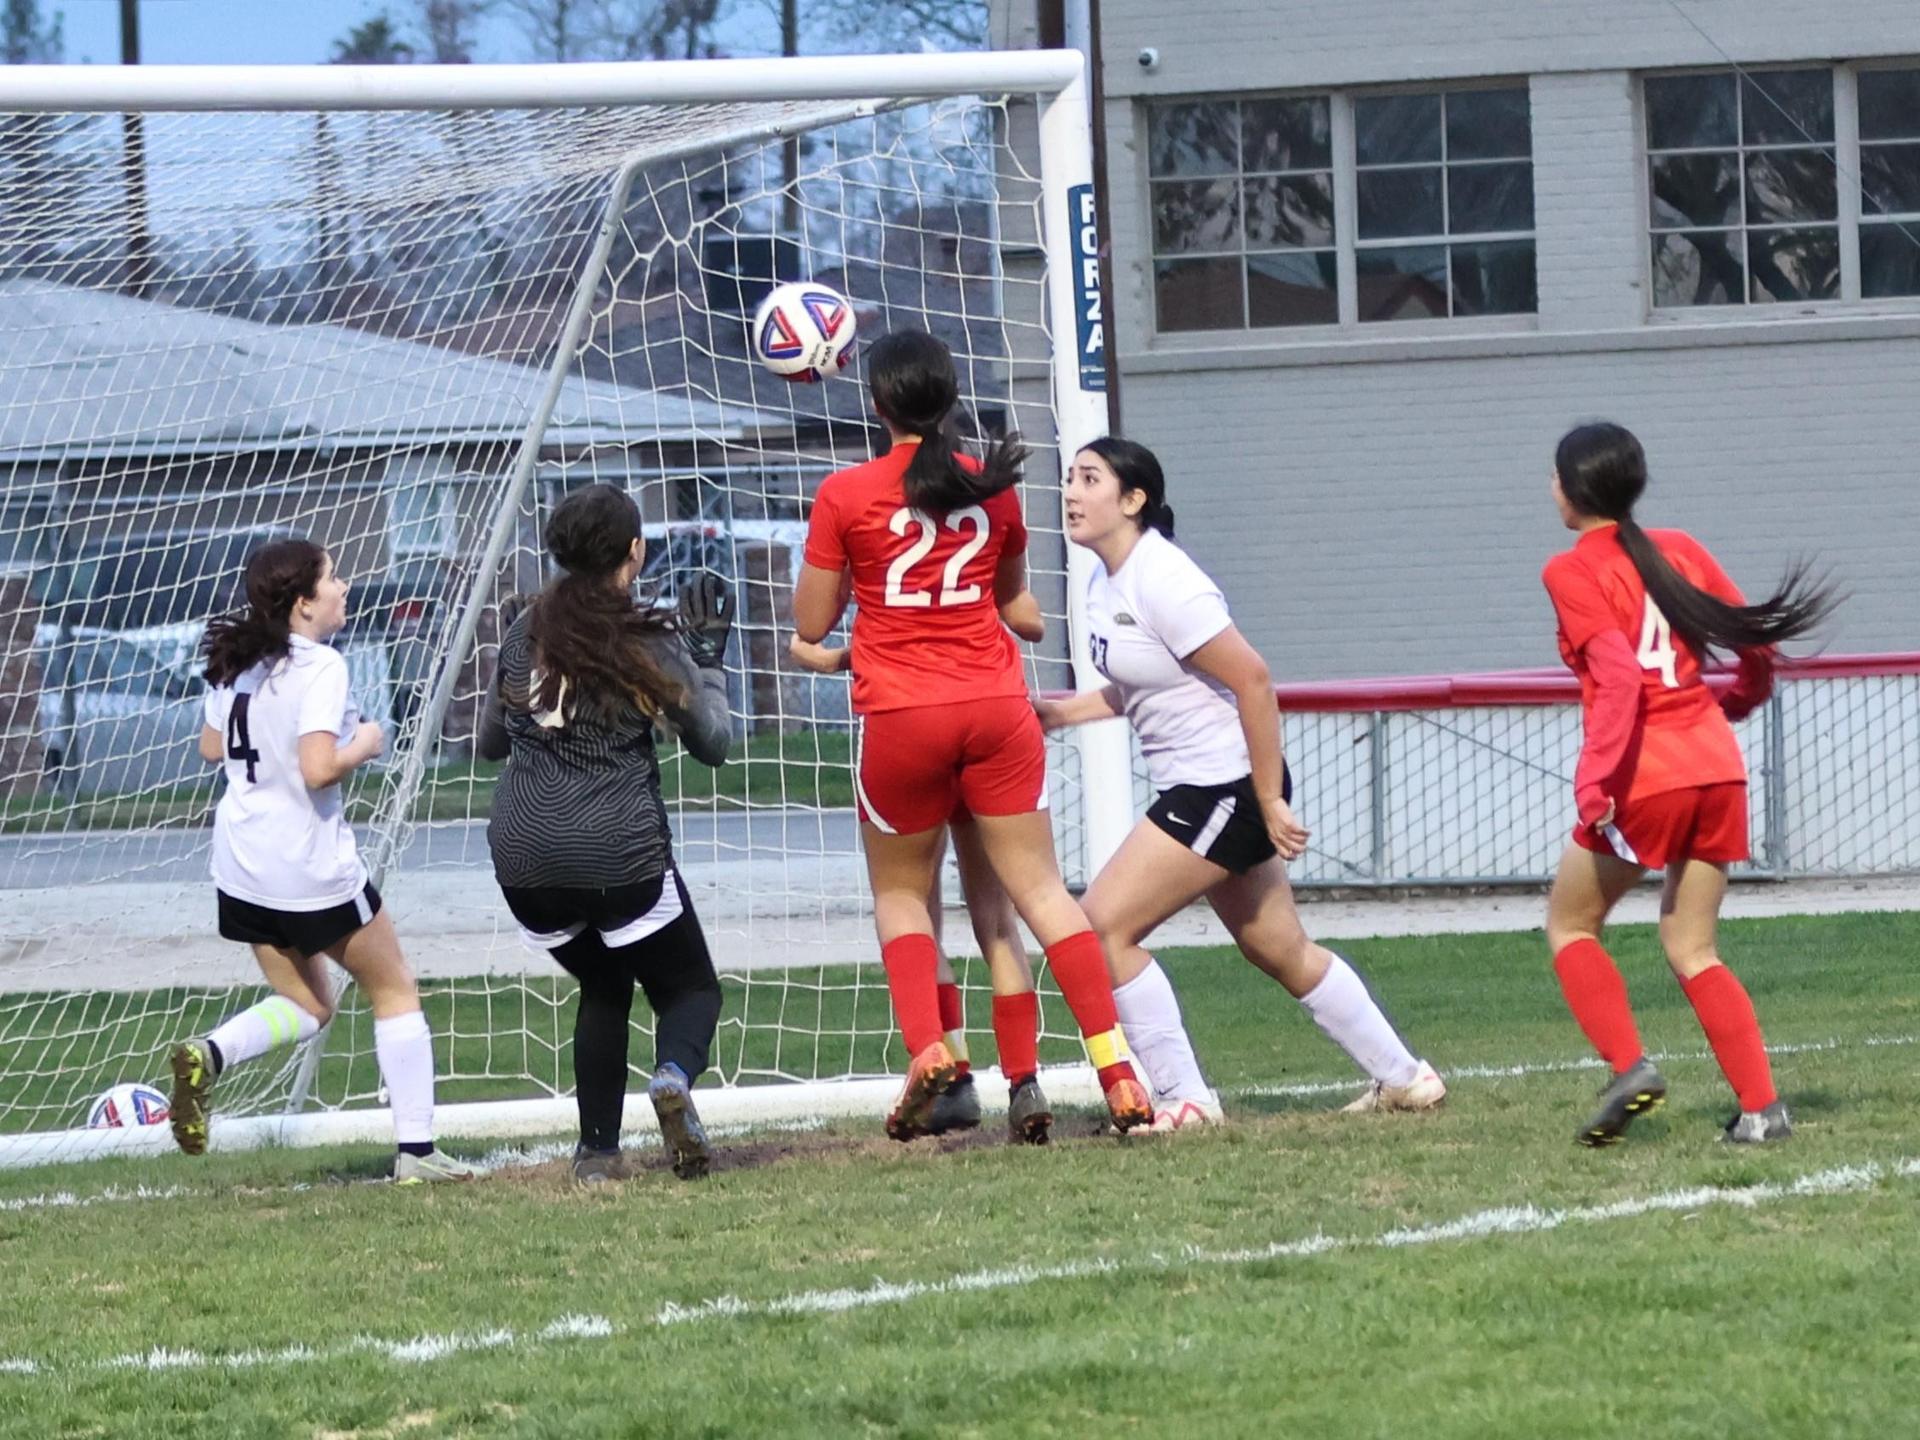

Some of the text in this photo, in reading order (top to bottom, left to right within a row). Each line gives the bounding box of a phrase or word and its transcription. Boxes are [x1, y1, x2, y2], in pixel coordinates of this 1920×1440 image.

[884, 505, 990, 607] 22
[1636, 591, 1680, 689] 4
[227, 692, 260, 784] 4
